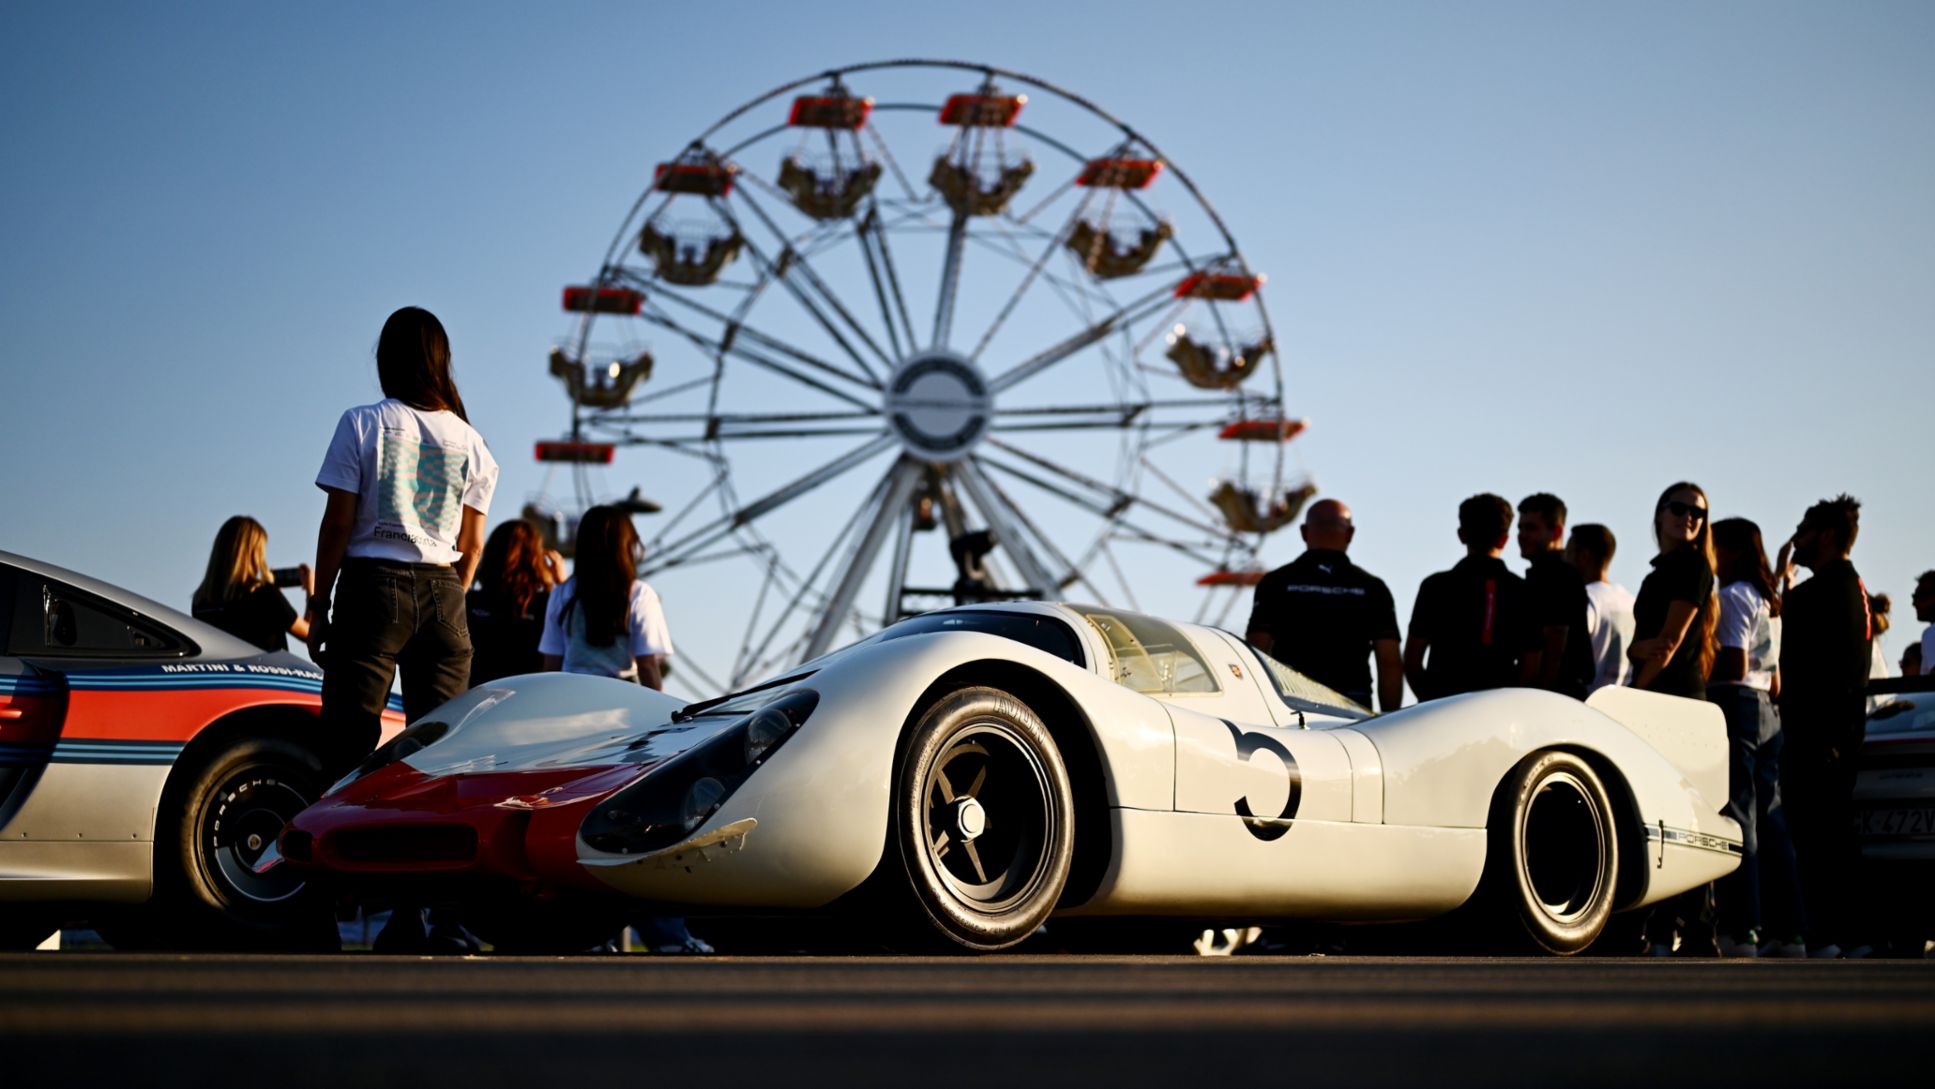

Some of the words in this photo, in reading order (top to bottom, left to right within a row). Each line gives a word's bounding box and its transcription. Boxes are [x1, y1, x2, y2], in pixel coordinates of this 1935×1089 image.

[1286, 584, 1366, 597] PORSCHE
[161, 663, 230, 673] MARTINI
[233, 663, 246, 673] &
[213, 778, 277, 848] PORSCHE
[1678, 831, 1729, 851] PORSCHE
